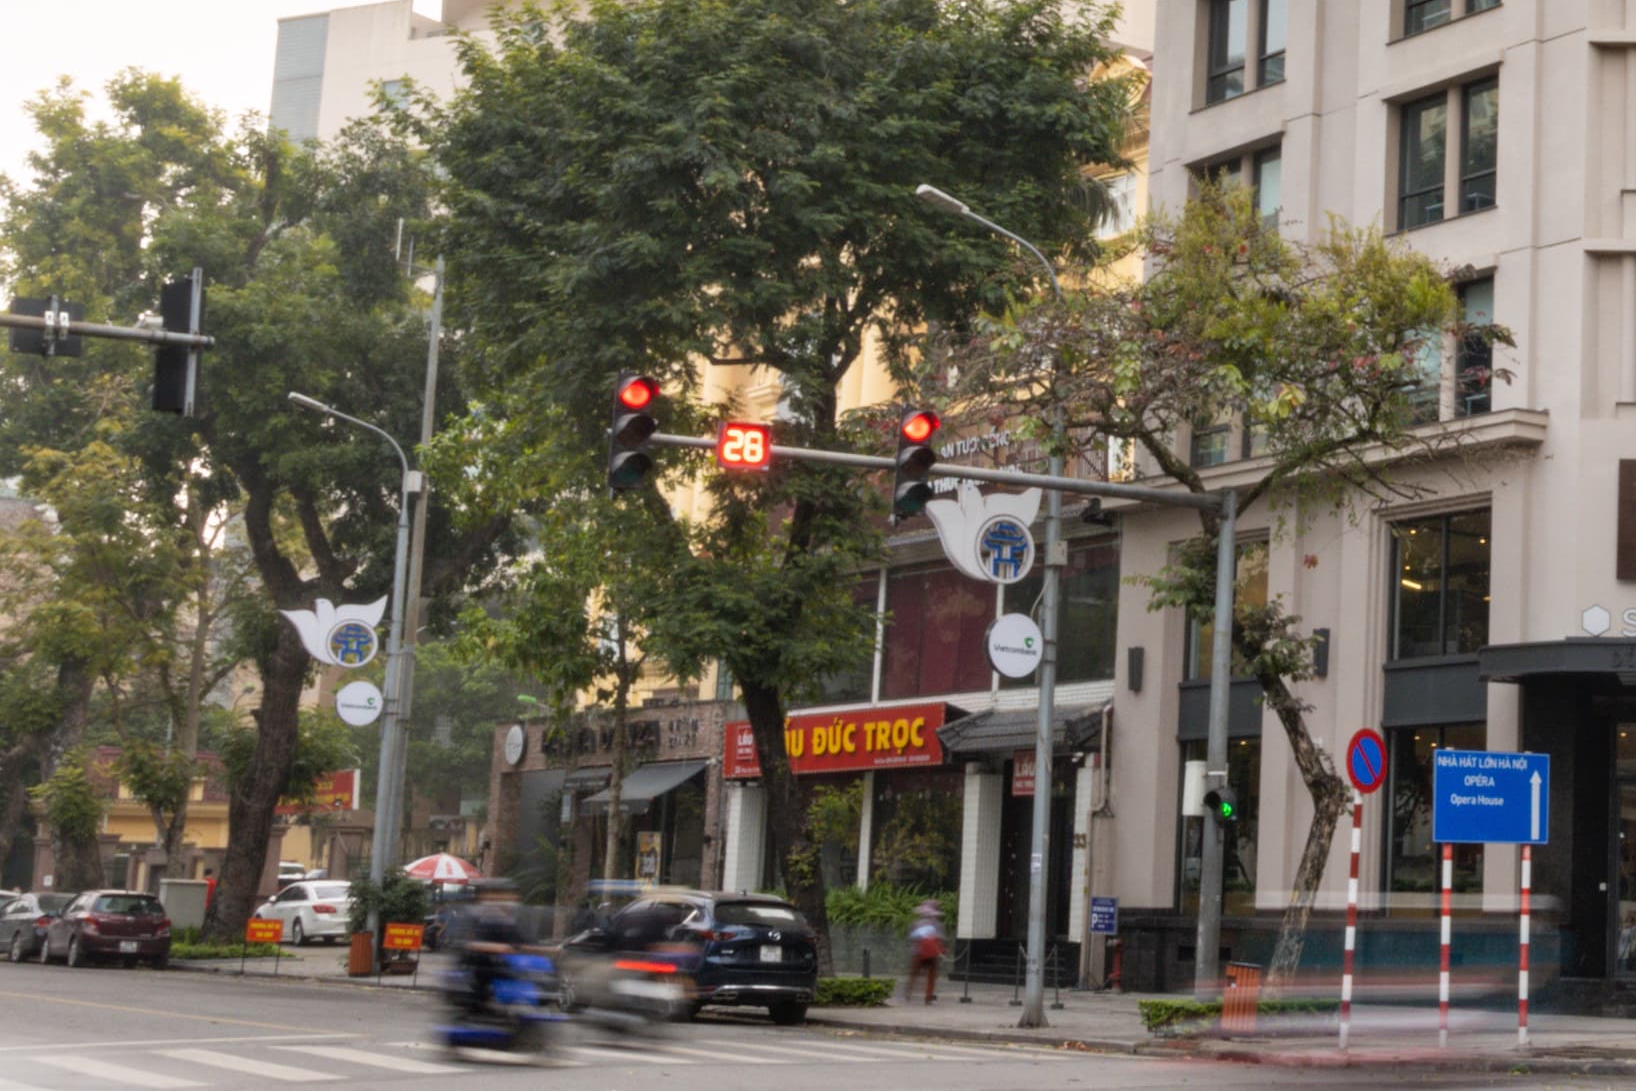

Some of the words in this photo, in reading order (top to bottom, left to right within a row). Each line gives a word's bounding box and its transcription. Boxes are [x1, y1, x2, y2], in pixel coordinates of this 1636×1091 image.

[722, 429, 763, 463] 28
[863, 717, 925, 755] TRỌC
[1438, 754, 1458, 767] NHÀ
[1459, 755, 1477, 768] HÁT
[1499, 756, 1511, 770] HÀ
[1512, 757, 1528, 771] NỘI
[1464, 774, 1496, 787] OPÉRA
[1450, 793, 1477, 807] Opera
[1478, 794, 1504, 806] House
